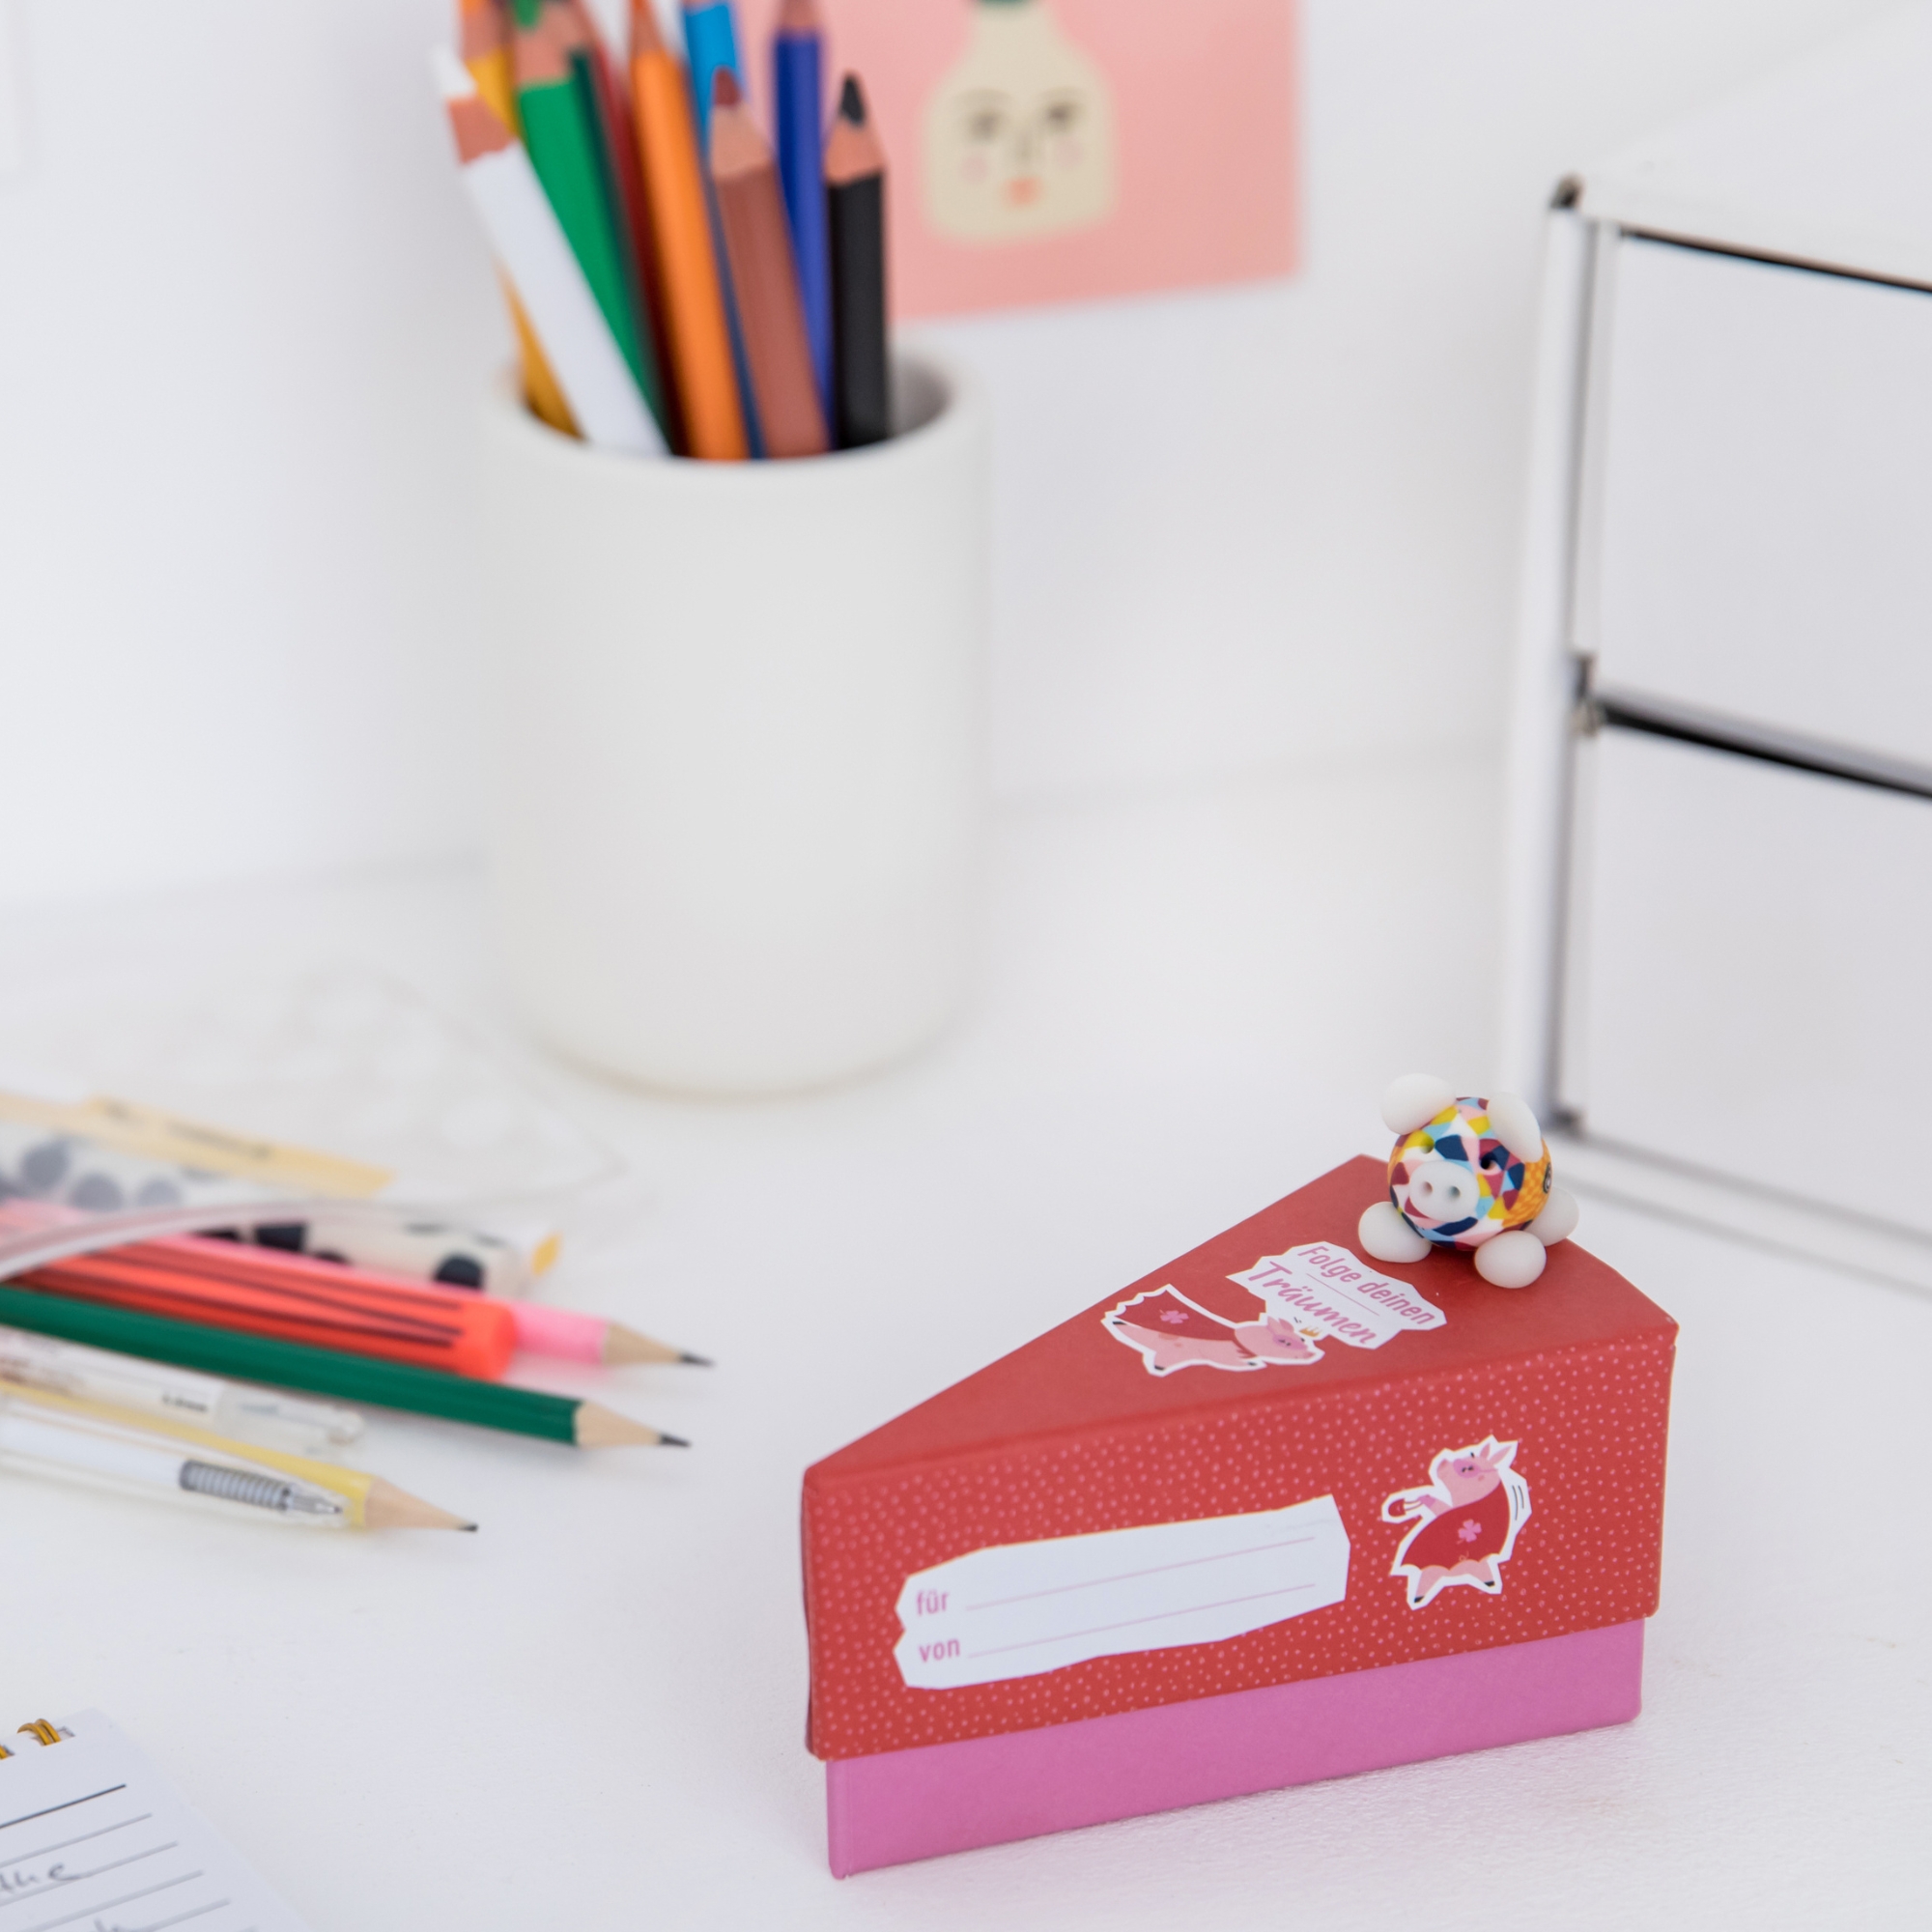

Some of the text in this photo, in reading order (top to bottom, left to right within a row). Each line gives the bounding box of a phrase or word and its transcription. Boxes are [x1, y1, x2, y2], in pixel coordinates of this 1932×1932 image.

[1247, 1261, 1378, 1344] Träumen
[1297, 1245, 1435, 1324] Folge deinen
[917, 1589, 949, 1615] für
[919, 1639, 959, 1662] von
